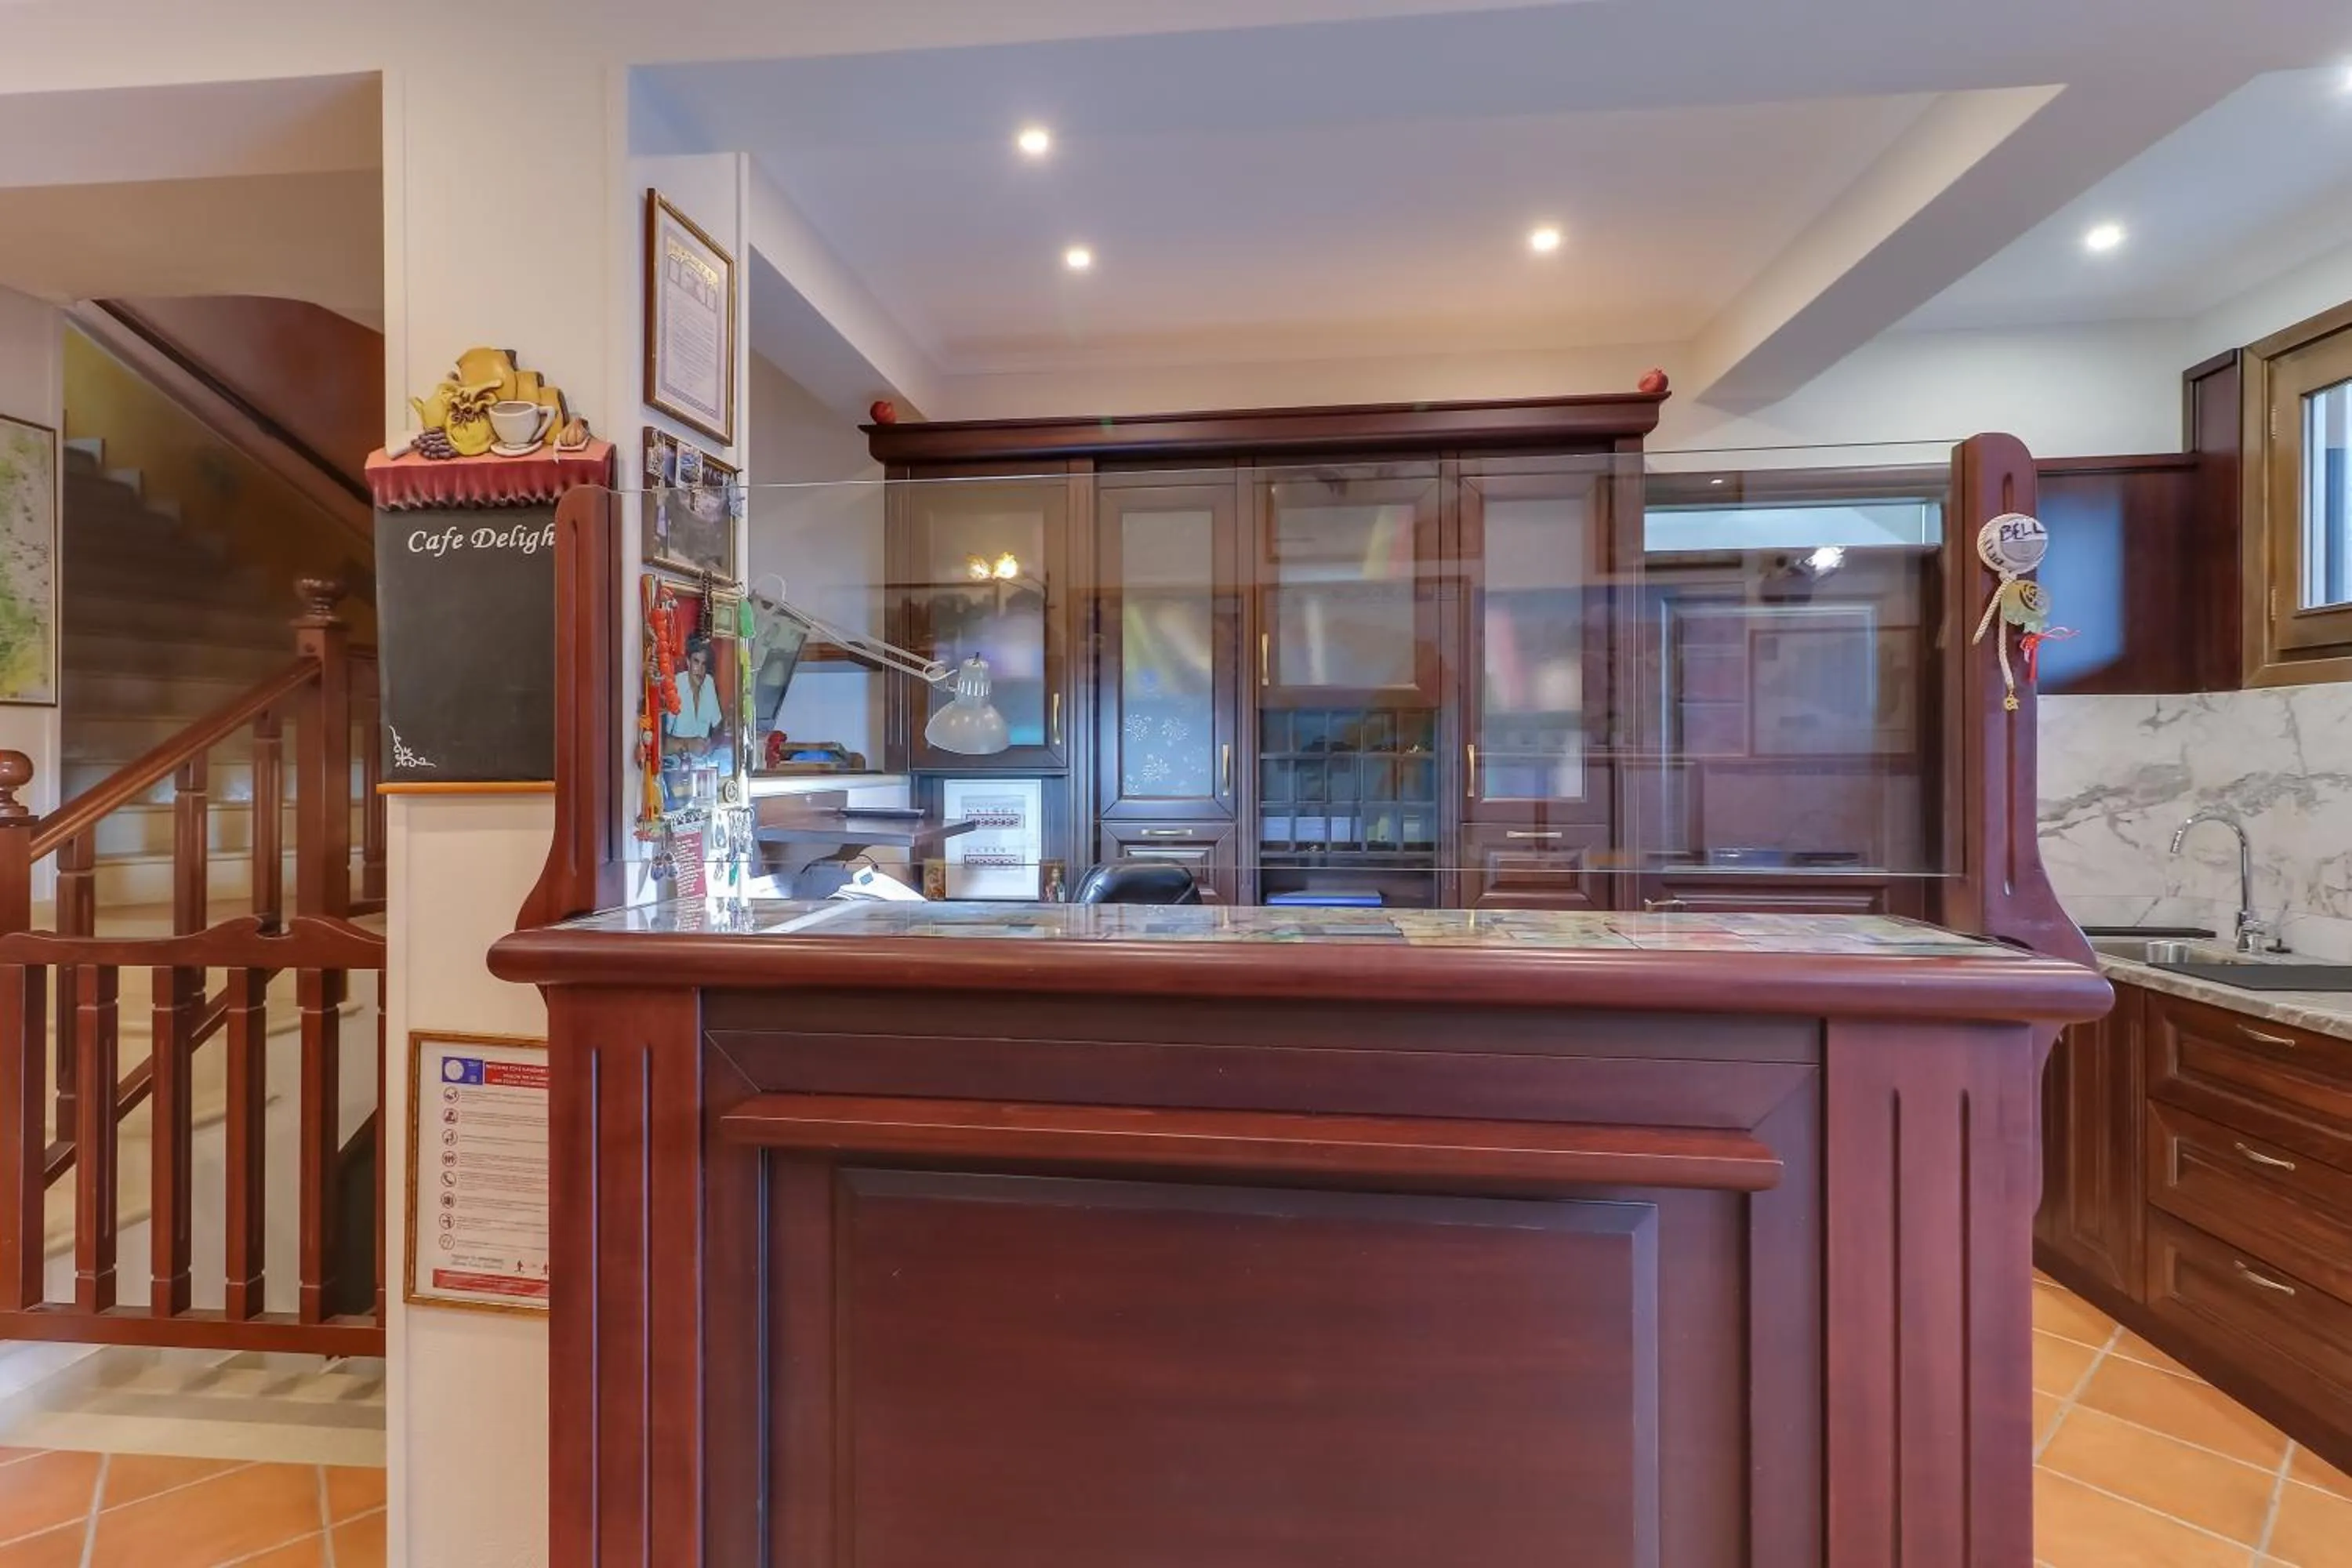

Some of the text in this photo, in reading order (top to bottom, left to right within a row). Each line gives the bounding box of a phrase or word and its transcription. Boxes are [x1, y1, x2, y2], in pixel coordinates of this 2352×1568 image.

[408, 523, 555, 557] Cafe Deligh
[1999, 522, 2045, 541] BELL
